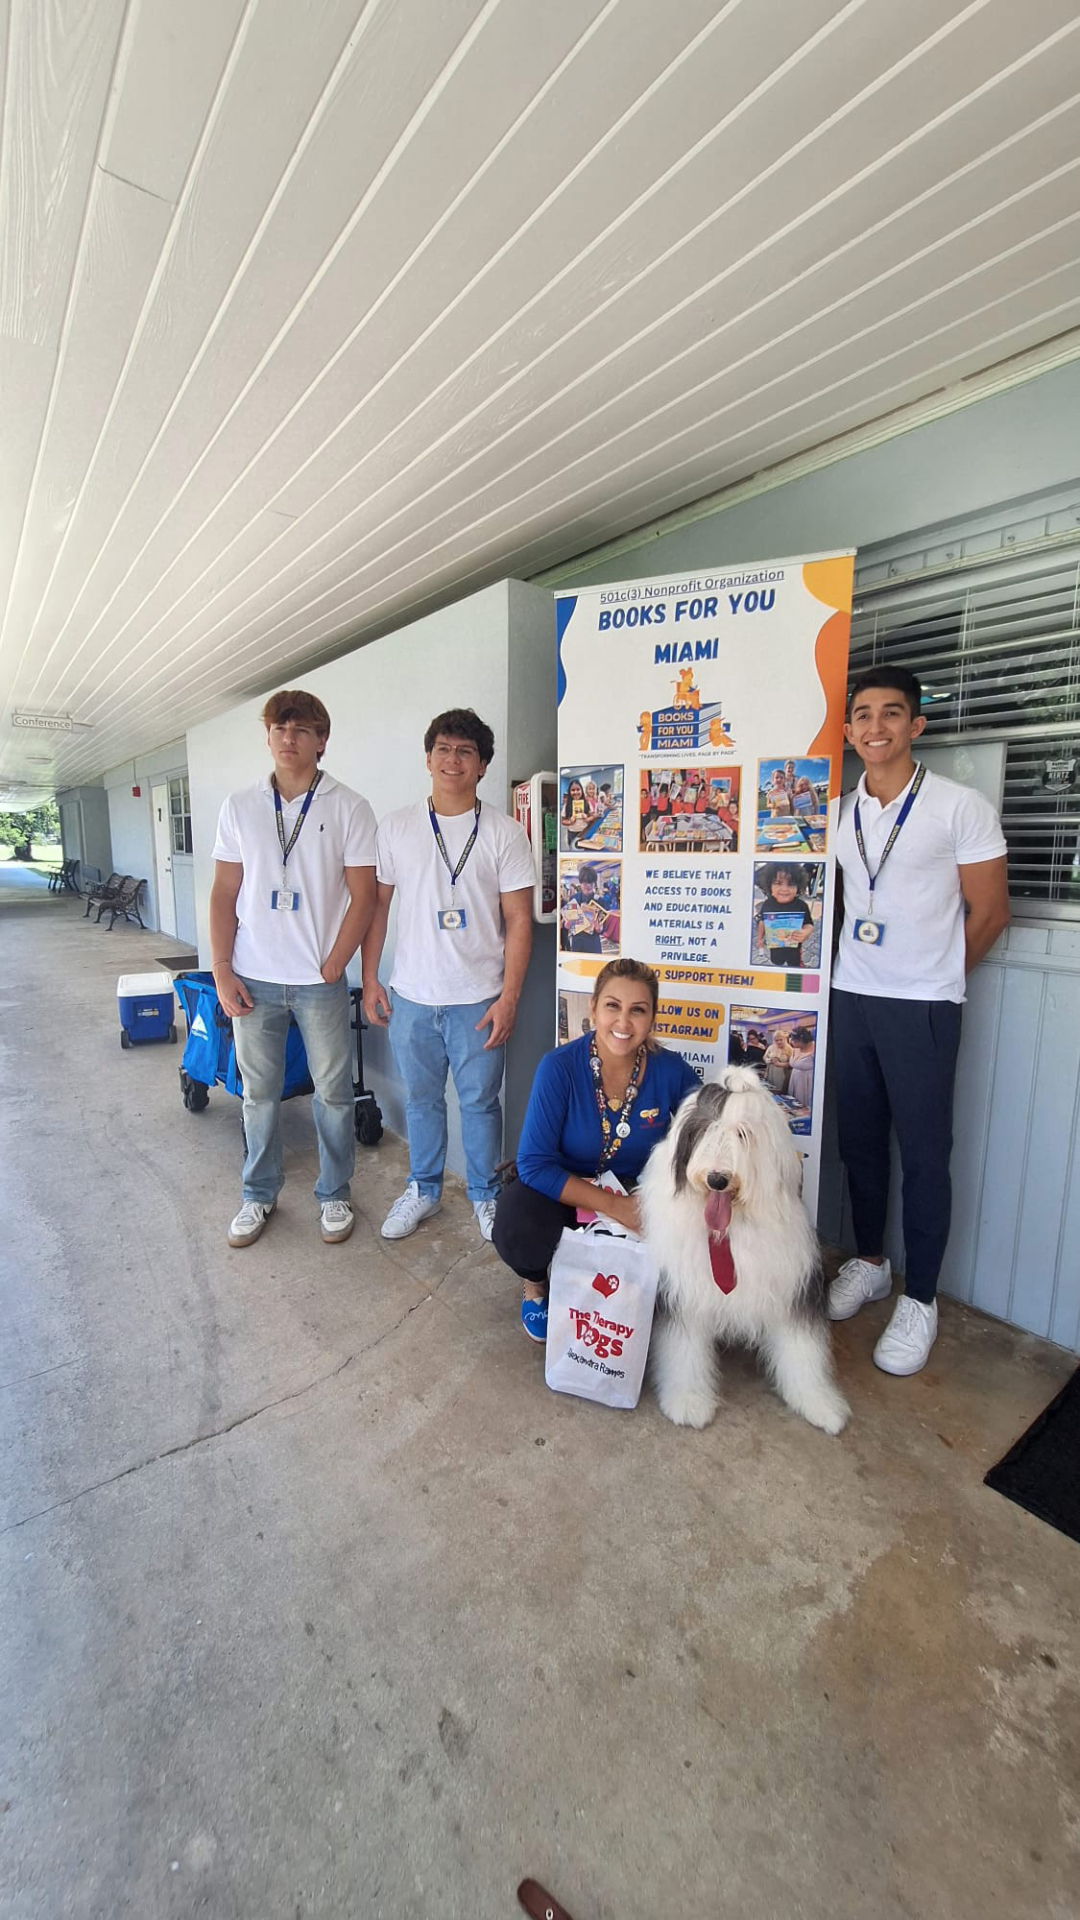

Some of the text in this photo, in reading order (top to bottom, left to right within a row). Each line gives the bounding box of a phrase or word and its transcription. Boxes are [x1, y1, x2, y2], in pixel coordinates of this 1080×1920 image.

[600, 569, 785, 603] 501c(3) Nonprofit Organization
[598, 589, 776, 631] BOOKS FOR YOU
[654, 638, 719, 664] MIAMI
[14, 716, 71, 728] Conference
[658, 712, 694, 722] BOOKS
[658, 726, 693, 735] FOR YOU
[657, 739, 693, 748] MIAMI
[518, 793, 529, 805] FIRE
[645, 870, 731, 880] WE BELIEVE THAT
[645, 886, 731, 897] ACCESS TO BOOKS
[644, 902, 732, 914] AND EDUCATIONAL
[649, 919, 724, 930] MATERIALS IS A
[655, 935, 717, 947] RIGHT, NOT A
[661, 951, 711, 963] PRIVILEGE.
[665, 970, 714, 982] SUPPORT
[718, 974, 754, 986] THEM!
[687, 1007, 700, 1017] US
[704, 1009, 719, 1019] ON
[653, 1022, 713, 1037] STAGRAM!
[569, 1308, 591, 1320] The
[576, 1319, 623, 1358] Dogs
[600, 1362, 625, 1378] Ramos
